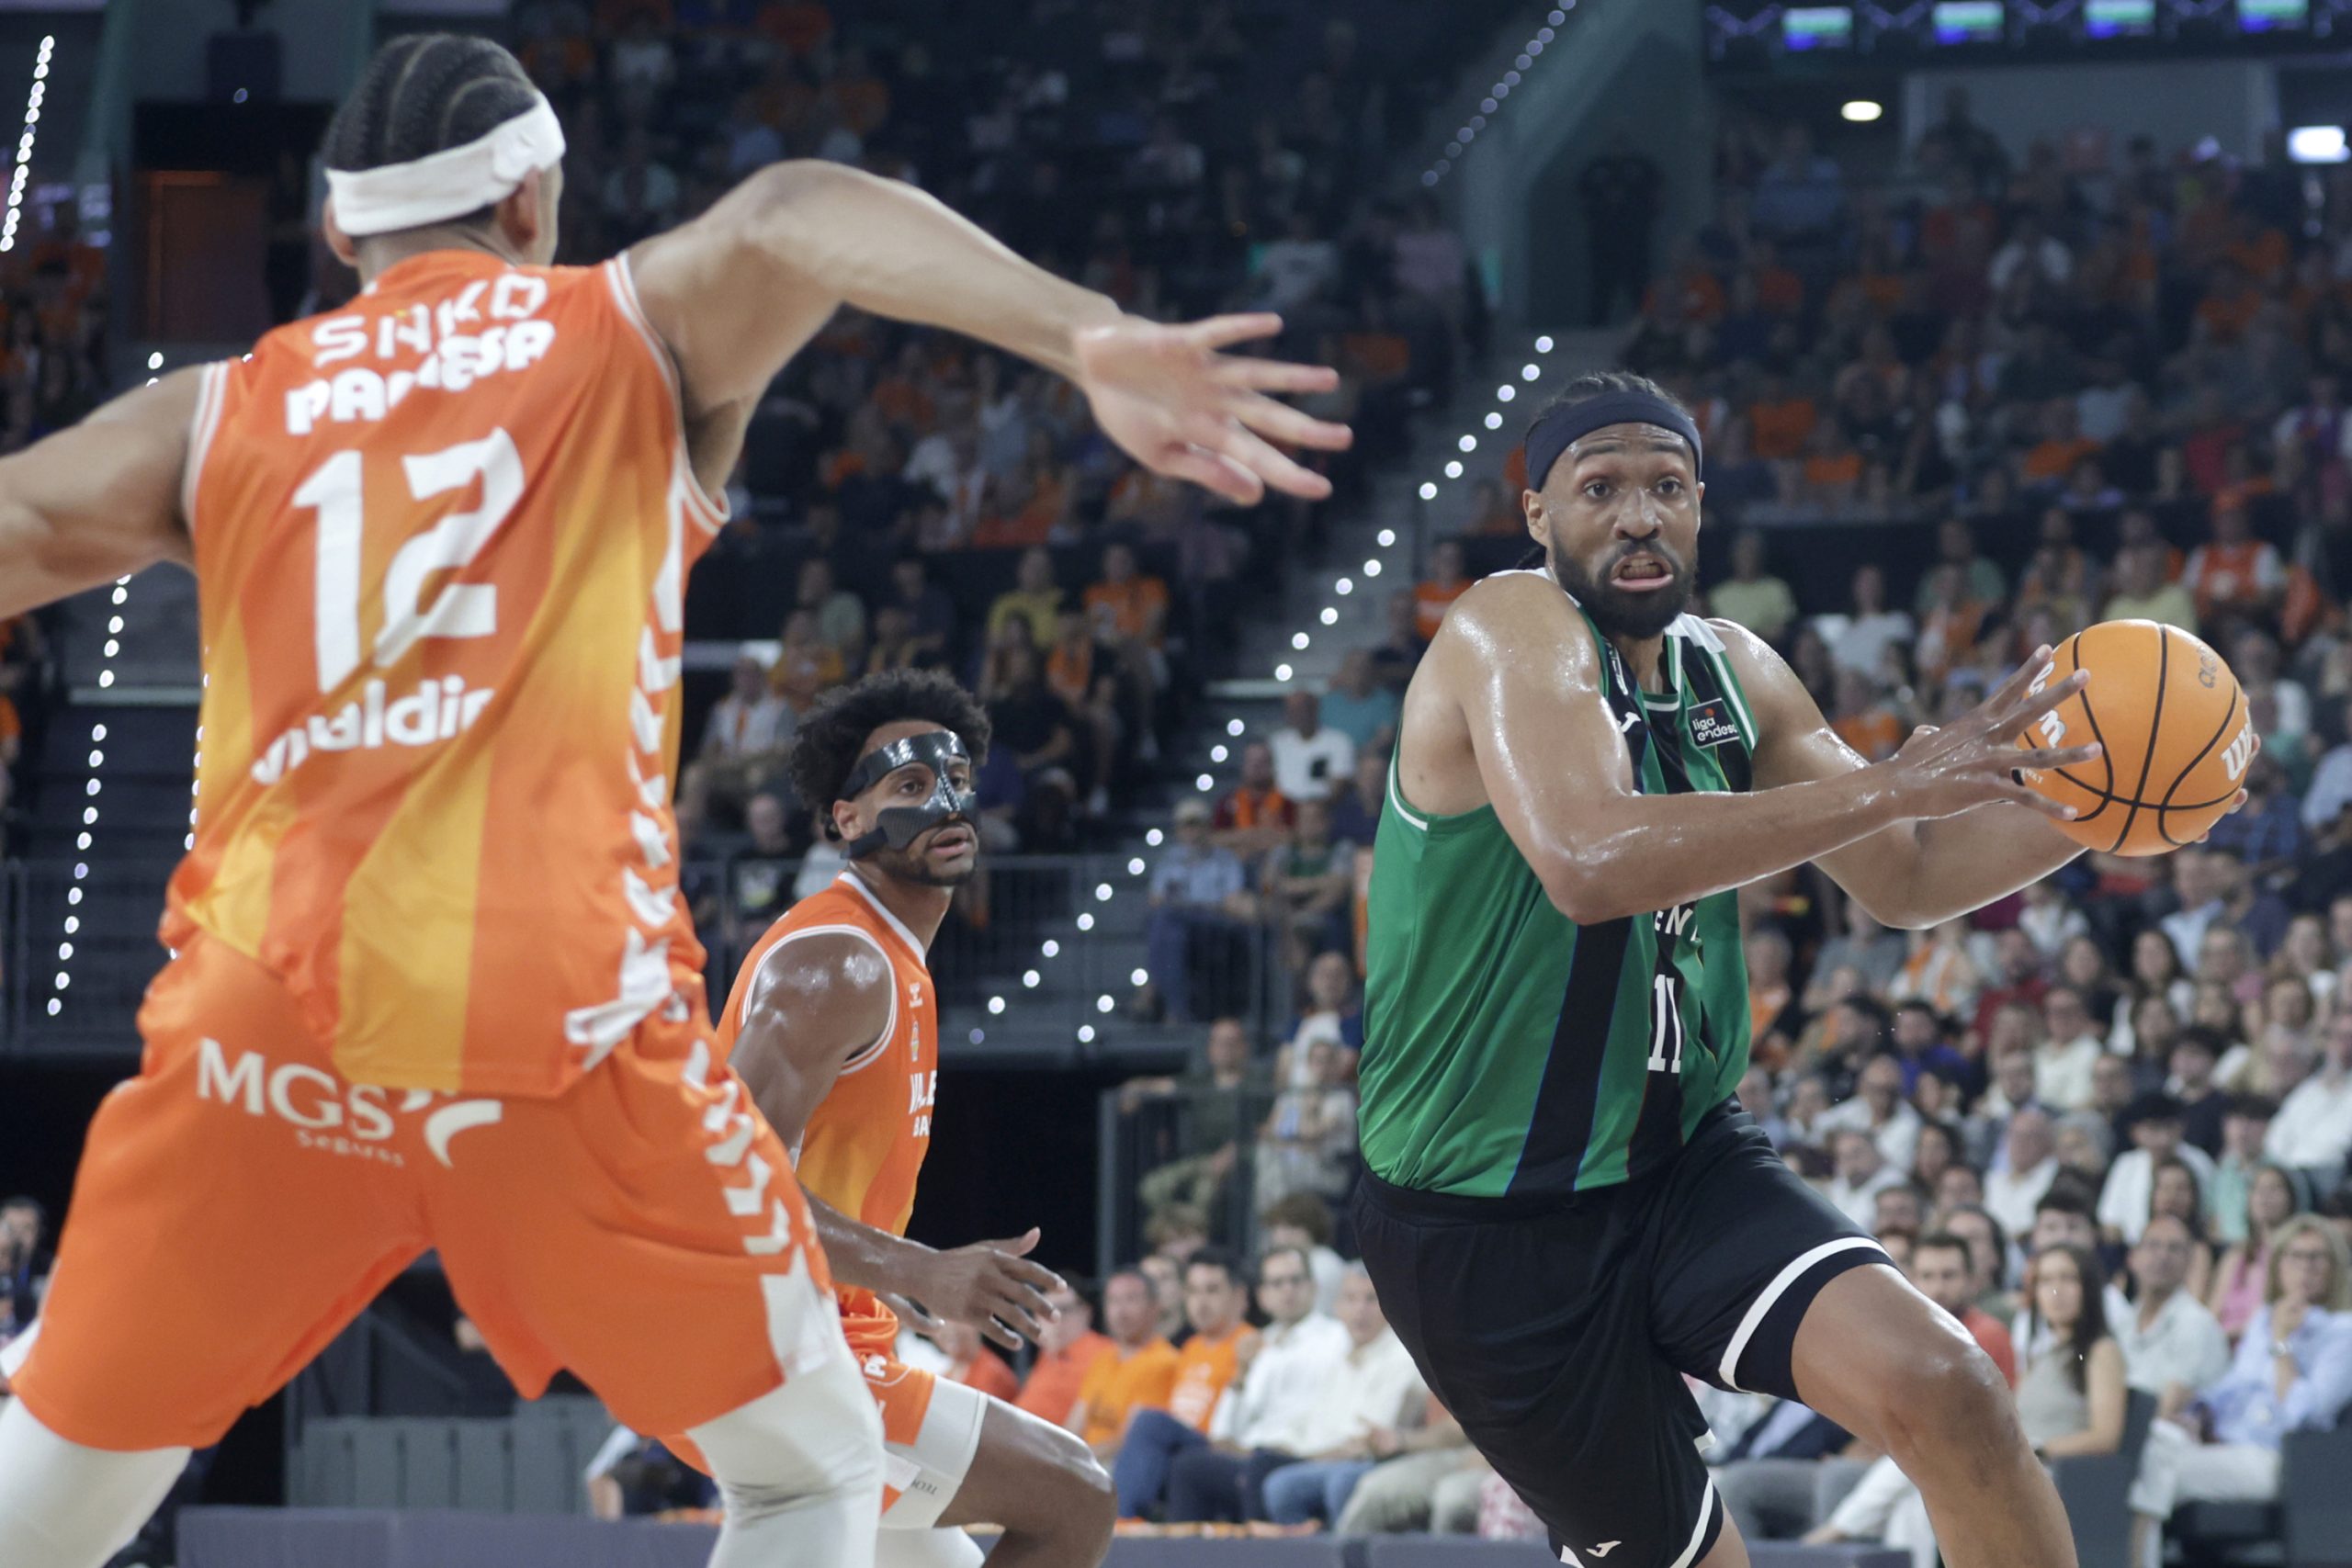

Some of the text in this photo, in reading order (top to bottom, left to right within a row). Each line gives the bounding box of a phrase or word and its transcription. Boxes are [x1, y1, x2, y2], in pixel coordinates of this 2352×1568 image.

[292, 426, 526, 694] 12
[1691, 716, 1716, 731] liga
[196, 1036, 394, 1140] MGS
